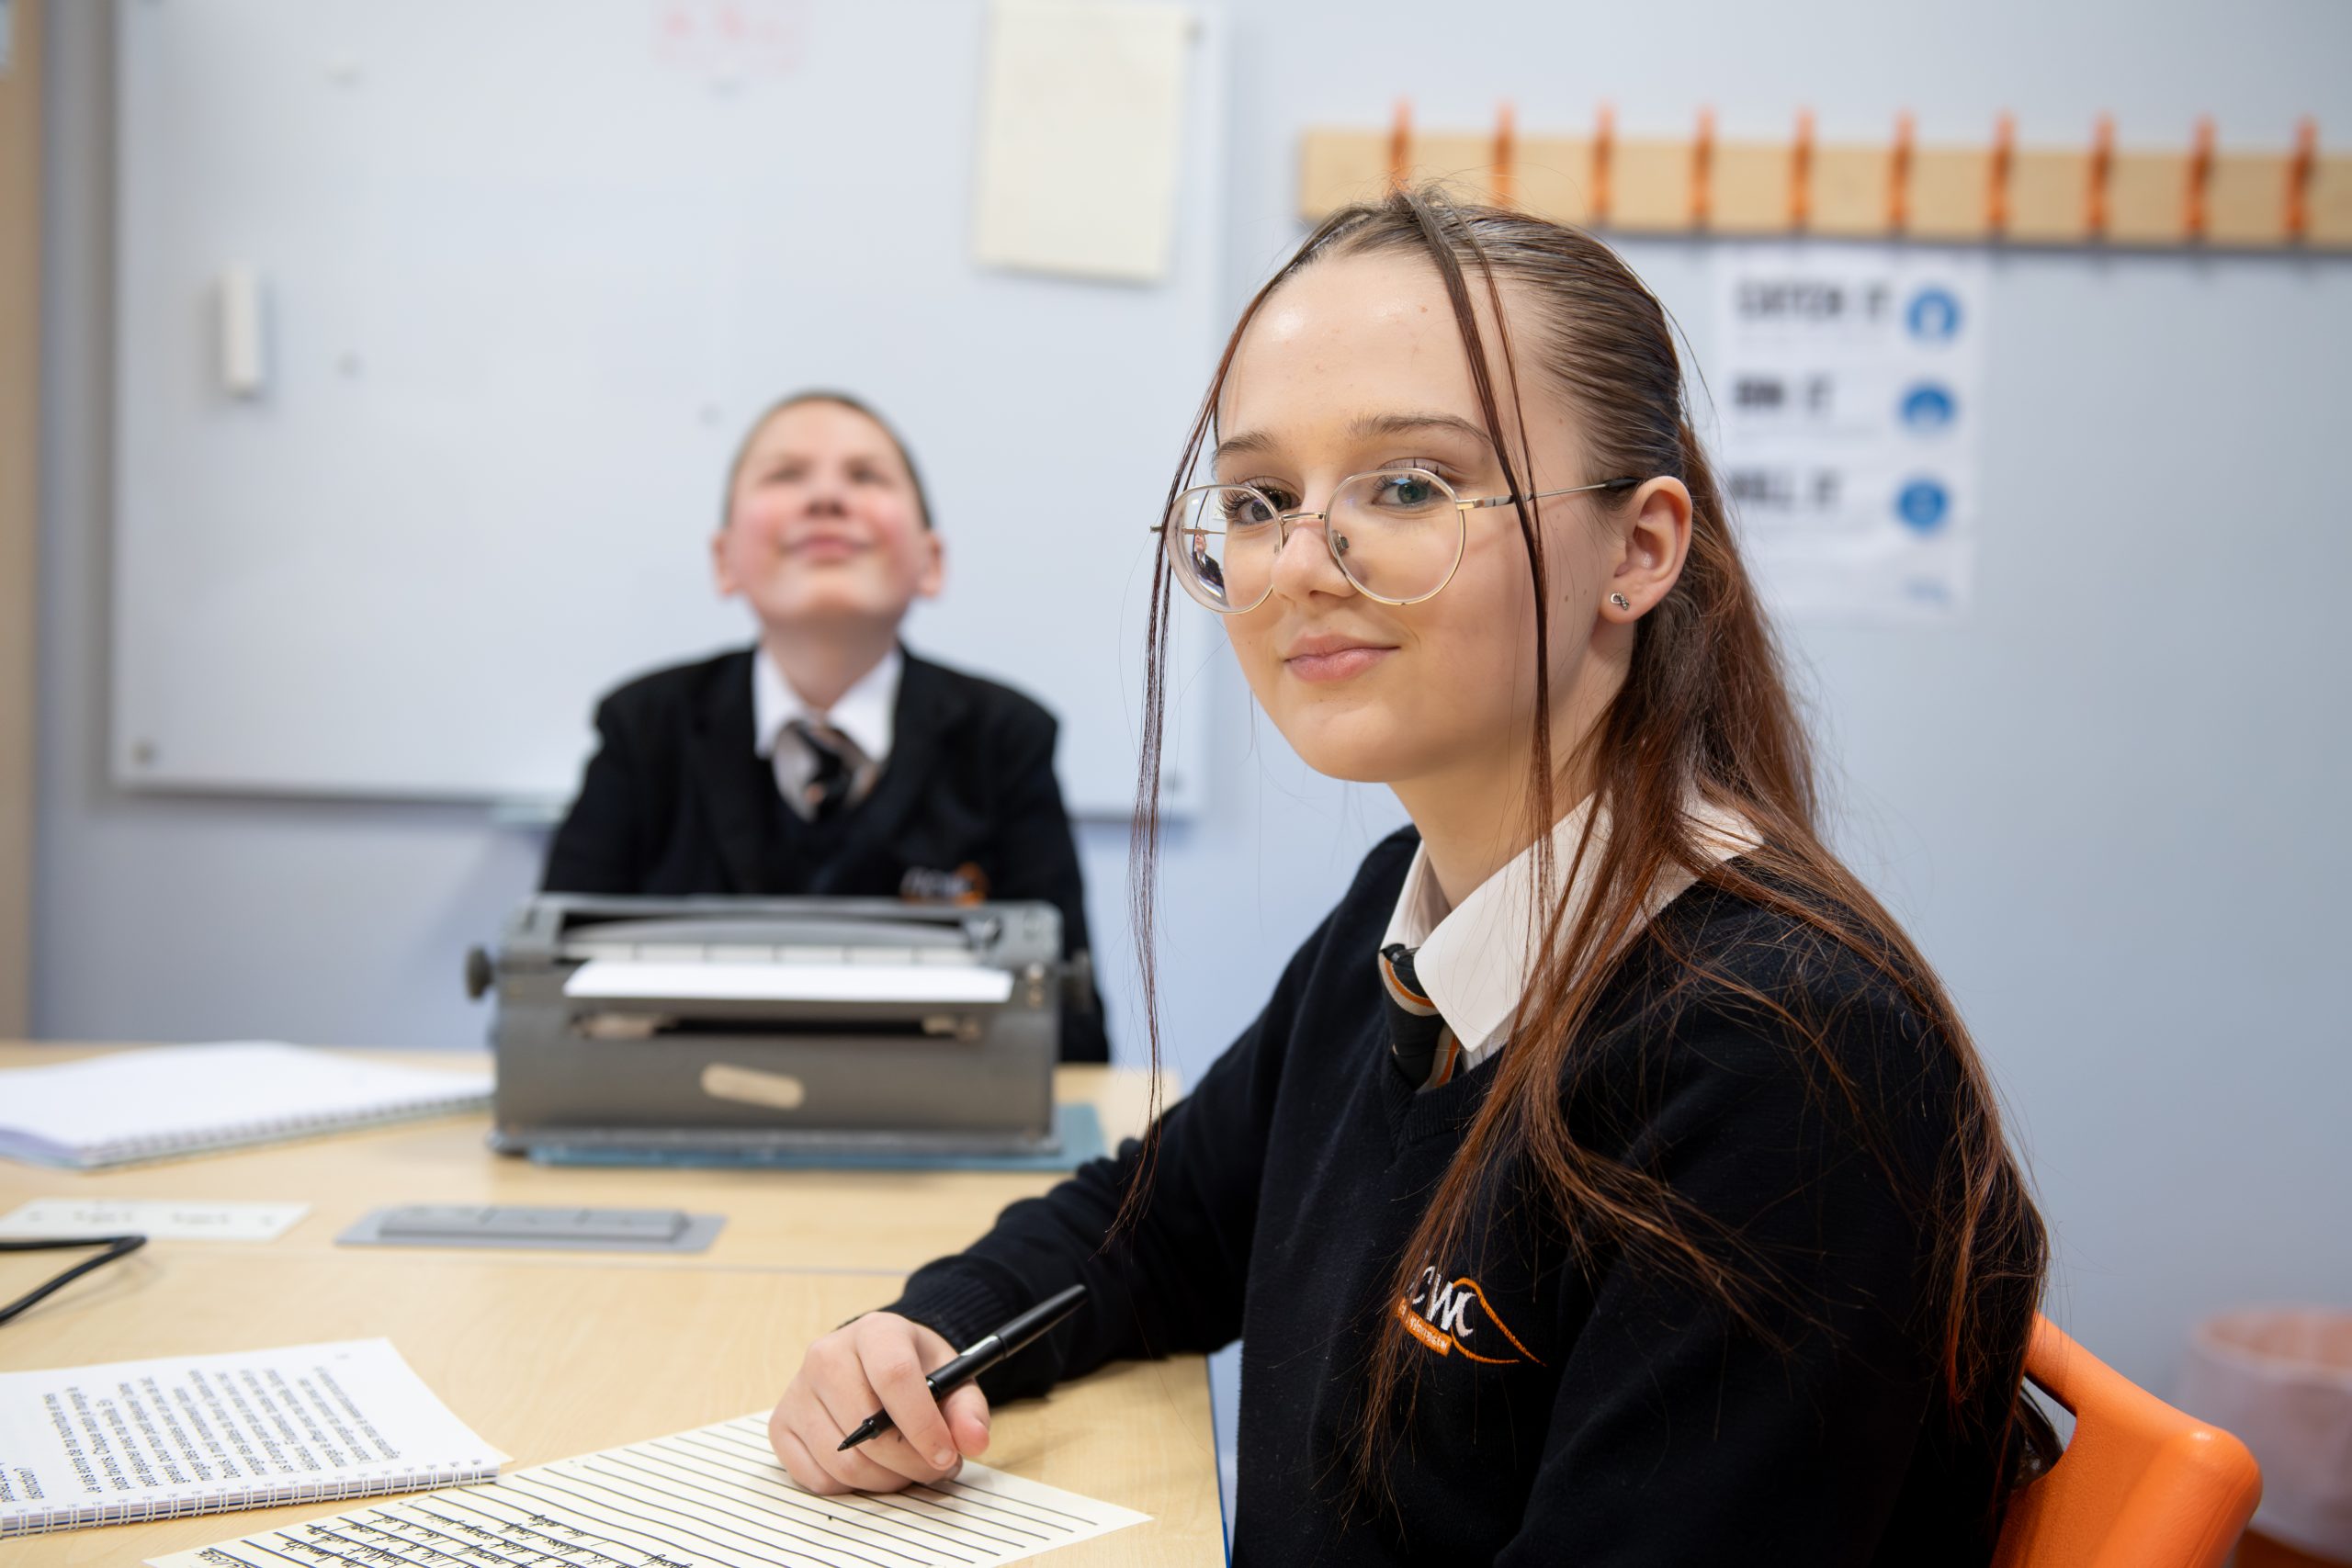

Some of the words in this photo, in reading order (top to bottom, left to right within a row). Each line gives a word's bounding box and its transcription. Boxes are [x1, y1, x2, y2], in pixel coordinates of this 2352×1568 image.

[88, 1432, 110, 1455] Chaque
[100, 1454, 122, 1476] favoris.
[12, 1467, 44, 1499] distinction?
[76, 1473, 97, 1486] vais
[109, 1476, 135, 1490] plats
[135, 1473, 163, 1487] petit
[396, 1544, 421, 1553] to
